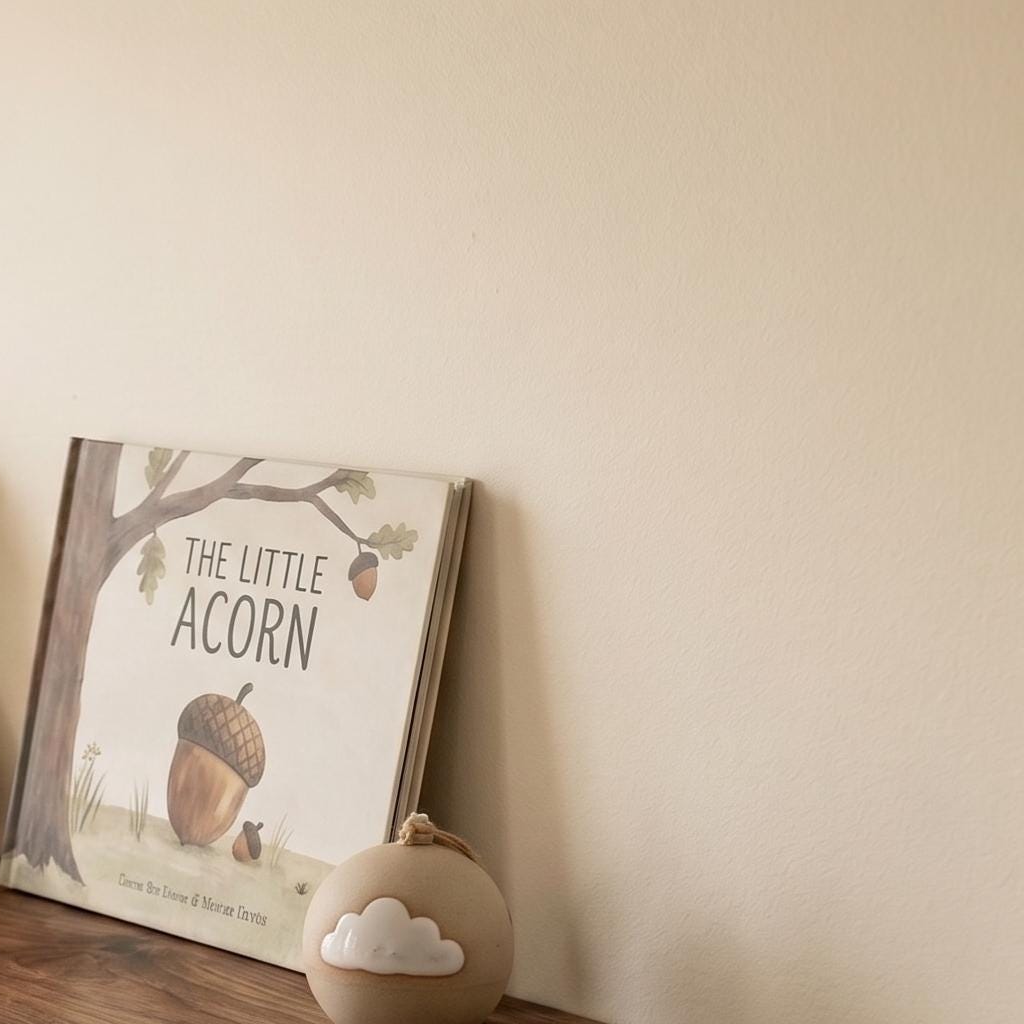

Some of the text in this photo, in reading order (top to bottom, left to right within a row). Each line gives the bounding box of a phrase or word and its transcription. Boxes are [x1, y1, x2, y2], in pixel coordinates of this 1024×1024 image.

[185, 536, 329, 595] THE LITTLE
[170, 586, 318, 671] ACORN
